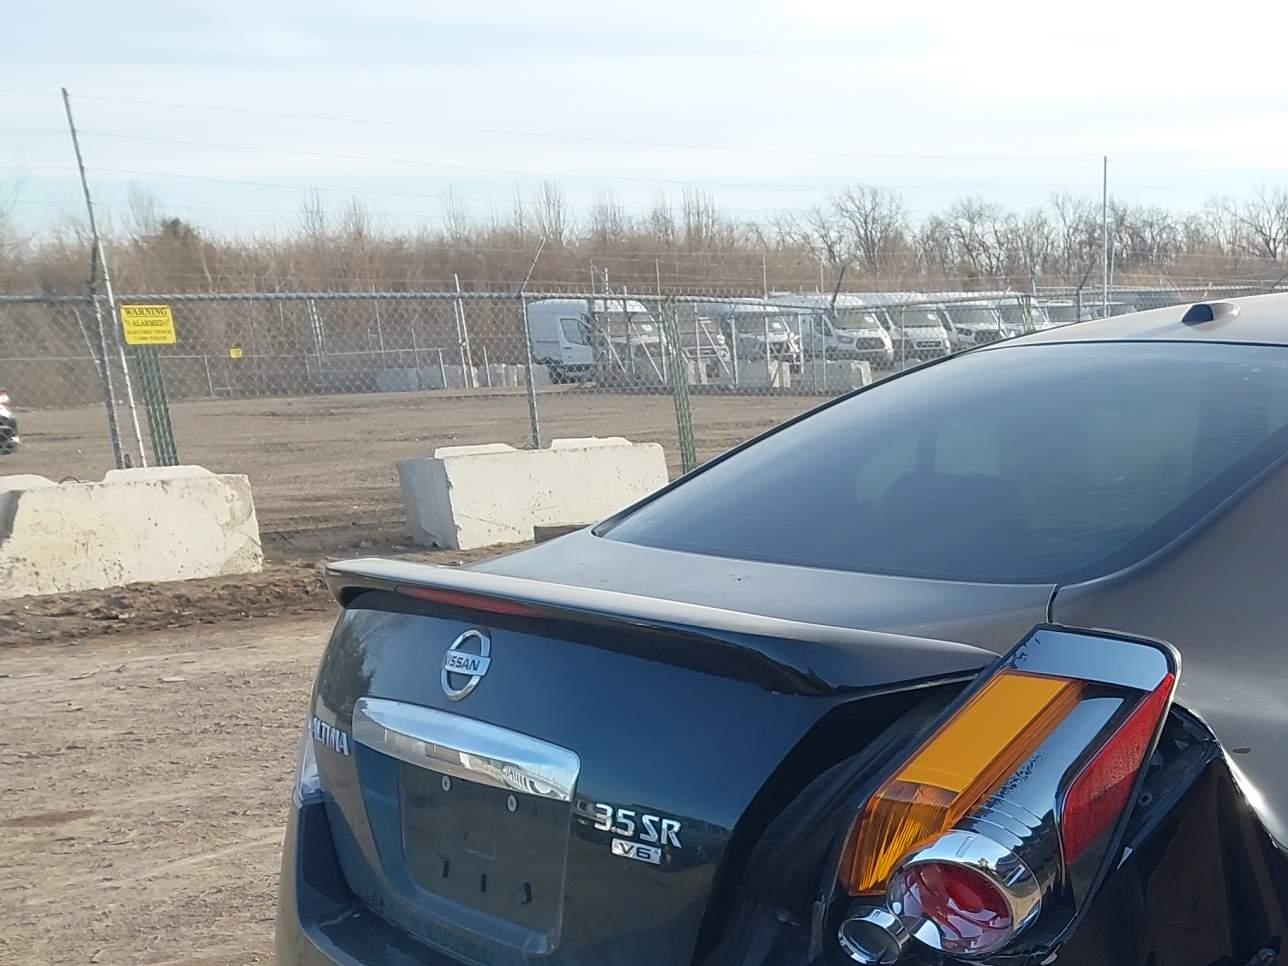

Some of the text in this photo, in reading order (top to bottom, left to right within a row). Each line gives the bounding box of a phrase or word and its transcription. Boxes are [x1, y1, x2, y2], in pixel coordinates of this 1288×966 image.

[124, 307, 168, 317] WARNING
[446, 654, 481, 671] ISSAN
[594, 803, 682, 849] 3.5 SR
[619, 842, 652, 860] V6
